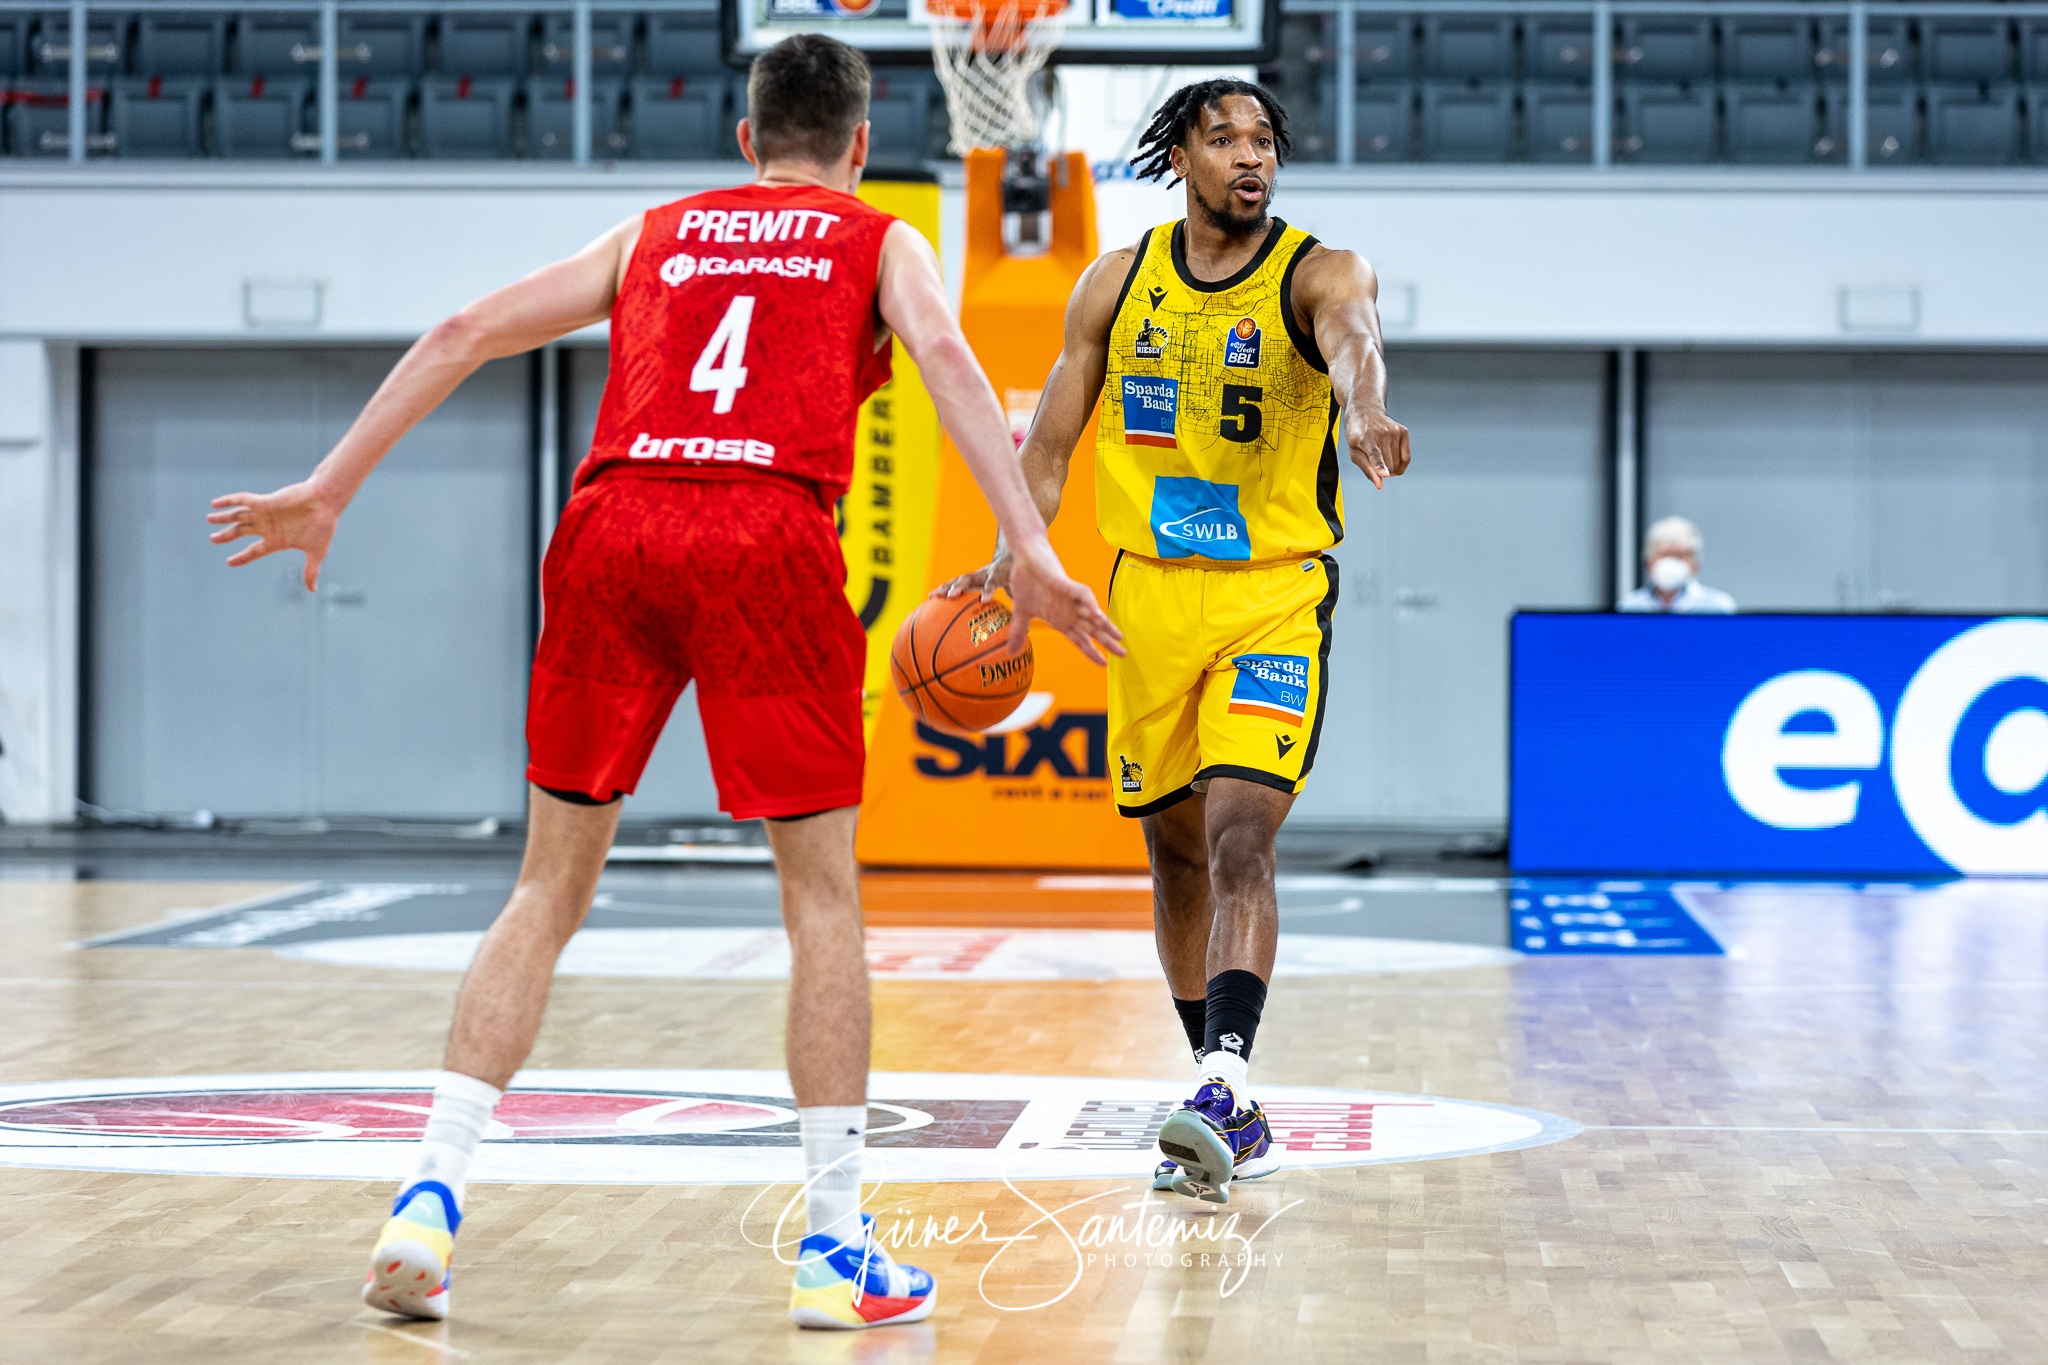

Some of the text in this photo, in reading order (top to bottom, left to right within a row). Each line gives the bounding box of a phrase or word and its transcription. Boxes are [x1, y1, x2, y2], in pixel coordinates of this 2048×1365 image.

[676, 209, 841, 243] PREWITT
[697, 256, 833, 282] IGARASHI
[689, 295, 756, 414] 4
[1136, 346, 1160, 354] RIESEN
[1227, 352, 1255, 365] BBL
[1124, 381, 1175, 398] Sparda
[1142, 396, 1174, 412] Bank
[1220, 384, 1263, 443] 5
[628, 433, 775, 466] brose
[869, 377, 895, 565] BAMBER
[1182, 523, 1238, 540] SWLB
[1254, 667, 1306, 688] Bank
[1281, 691, 1304, 706] BW
